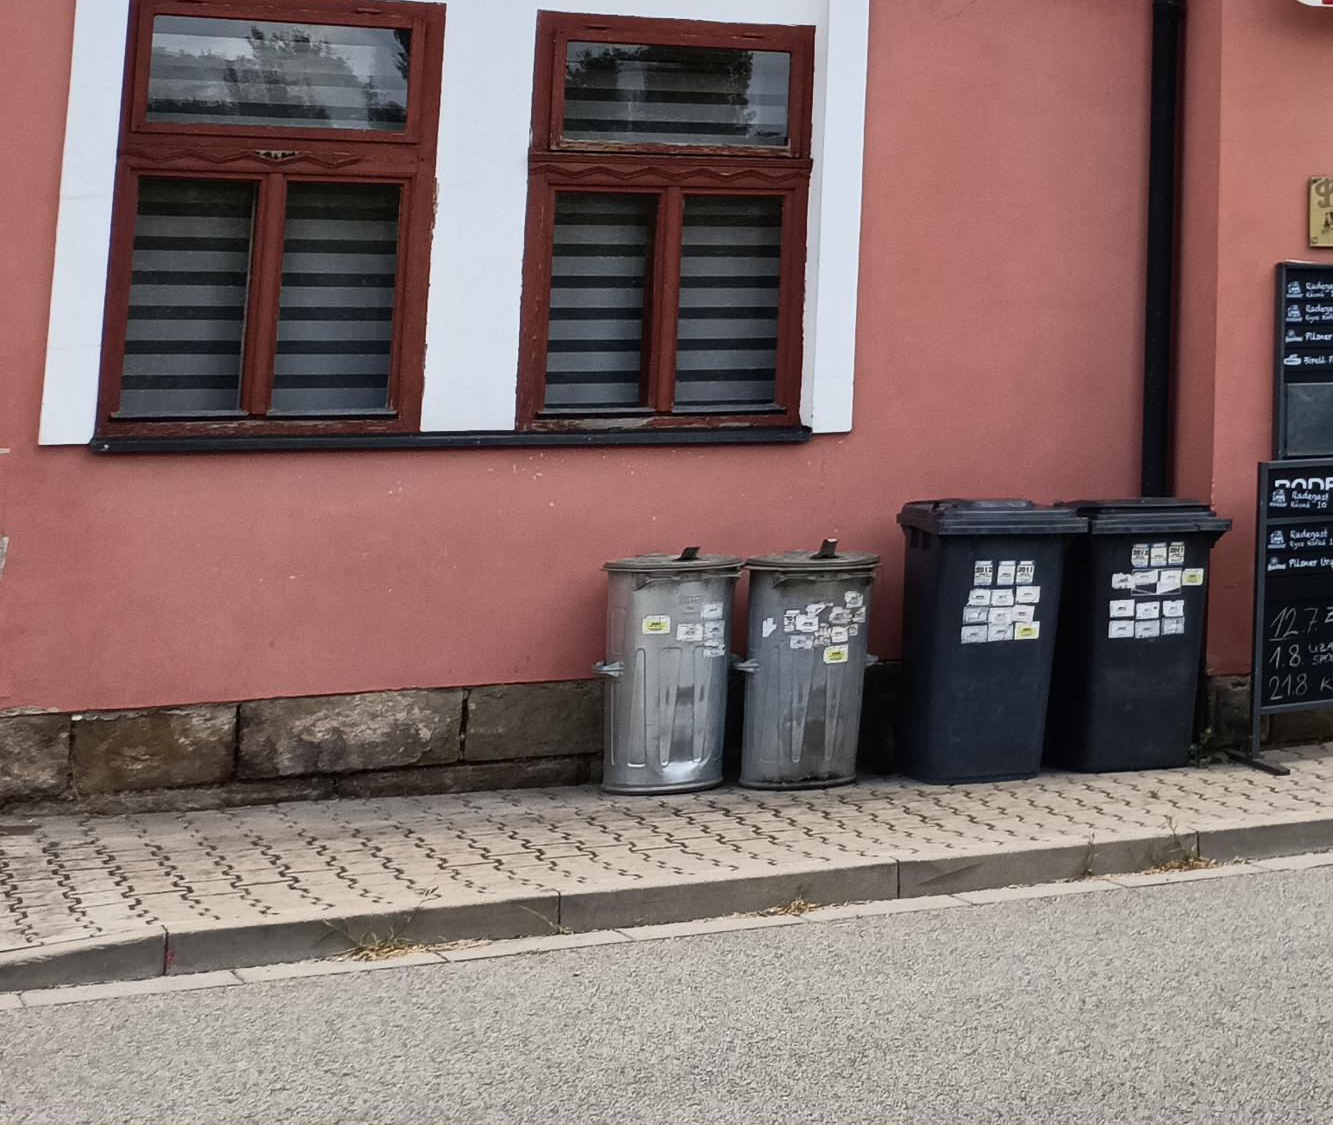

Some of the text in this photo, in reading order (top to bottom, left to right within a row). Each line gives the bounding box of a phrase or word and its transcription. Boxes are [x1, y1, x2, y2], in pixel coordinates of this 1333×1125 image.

[1305, 331, 1333, 341] Pilsner
[1291, 490, 1329, 502] Radegast
[1316, 501, 1328, 509] 10
[1289, 528, 1328, 541] Radegast
[1289, 558, 1318, 568] Pilsner
[1269, 643, 1304, 670] 1.8.
